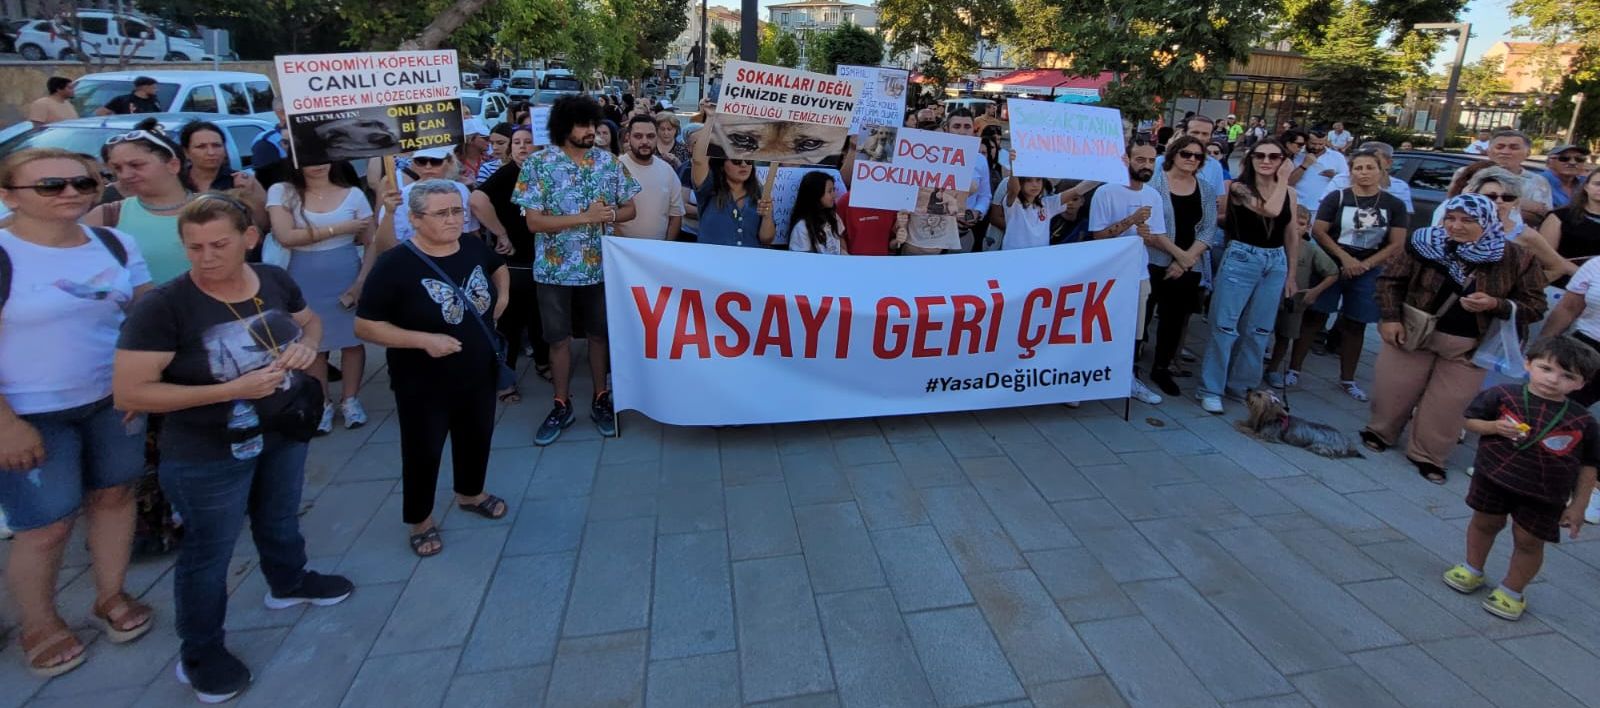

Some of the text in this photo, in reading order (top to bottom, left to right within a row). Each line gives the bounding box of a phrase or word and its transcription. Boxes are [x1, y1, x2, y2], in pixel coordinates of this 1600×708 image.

[283, 54, 453, 74] EKONOMİYİ KÖPEKLERİ
[308, 69, 442, 92] CANLI CANLI
[736, 68, 853, 98] SOKAKLARI DEĞİL
[293, 93, 356, 111] GÖMEREK
[360, 91, 374, 103] Mİ
[376, 86, 450, 104] ÇÖZECEKSİNİZ
[386, 101, 455, 118] ONLAR DA
[725, 83, 788, 104] İÇİNİZDE
[791, 94, 854, 112] BÜYÜYEN
[295, 110, 360, 124] UNUTMAYIN!
[402, 118, 445, 133] Bİ CAN
[723, 102, 782, 119] KÖTÜLÜĞÜ
[788, 109, 846, 126] TEMİZLEYİN!
[399, 133, 452, 150] TAŞIYOR
[898, 139, 966, 166] DOSTA
[857, 163, 956, 191] DOKUNMA
[630, 279, 1116, 360] YASAYI GERİ ÇEK
[924, 365, 1112, 394] #YasaDeğilCinayet
